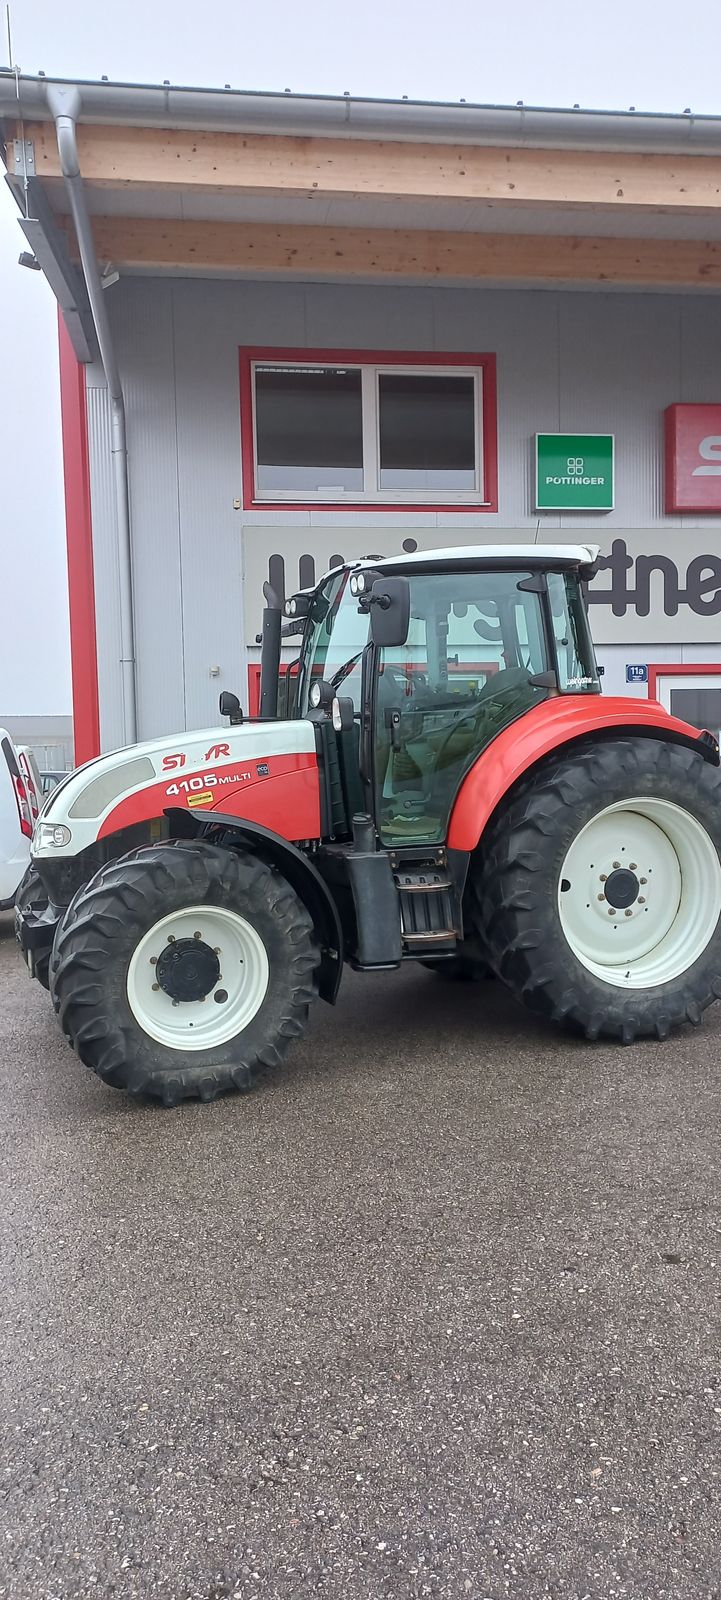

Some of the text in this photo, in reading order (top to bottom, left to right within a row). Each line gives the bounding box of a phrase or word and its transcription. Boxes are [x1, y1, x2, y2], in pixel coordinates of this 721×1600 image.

[630, 666, 644, 675] 11a
[166, 772, 251, 795] 4105 MULTI
